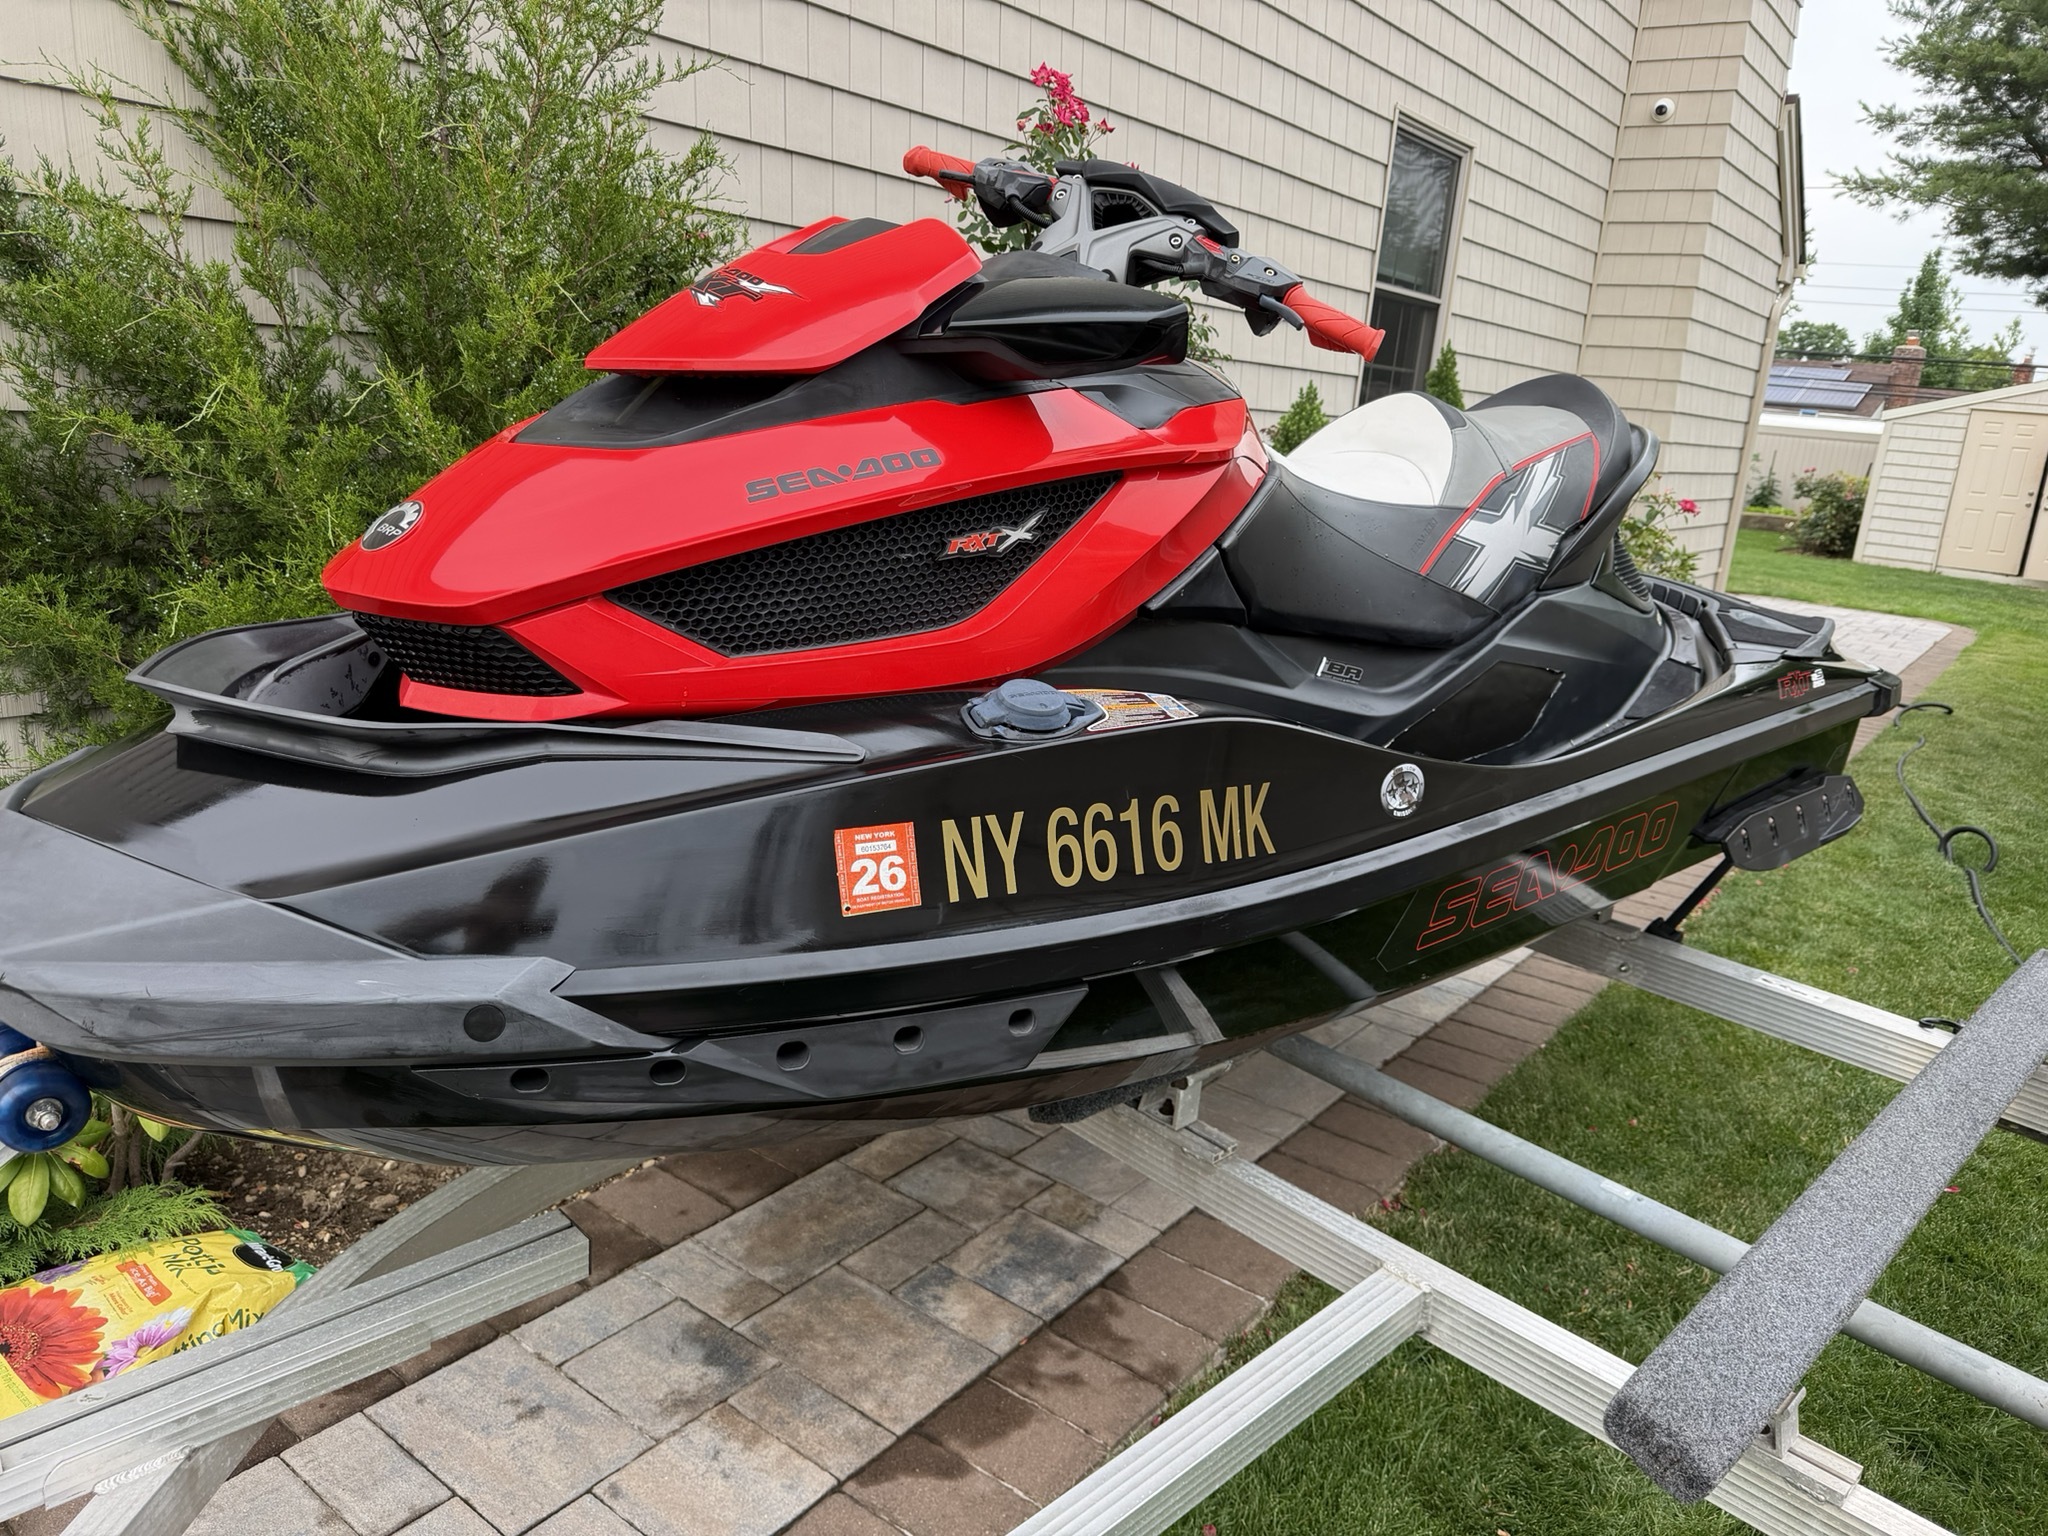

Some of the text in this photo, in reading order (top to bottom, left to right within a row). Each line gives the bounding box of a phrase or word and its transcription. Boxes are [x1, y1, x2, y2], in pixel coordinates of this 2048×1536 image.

[377, 523, 402, 536] BRP
[854, 830, 896, 841] NEW YORK
[942, 811, 1024, 903] NY
[1047, 795, 1184, 887] 6616
[1200, 782, 1276, 864] MK
[850, 855, 907, 896] 26
